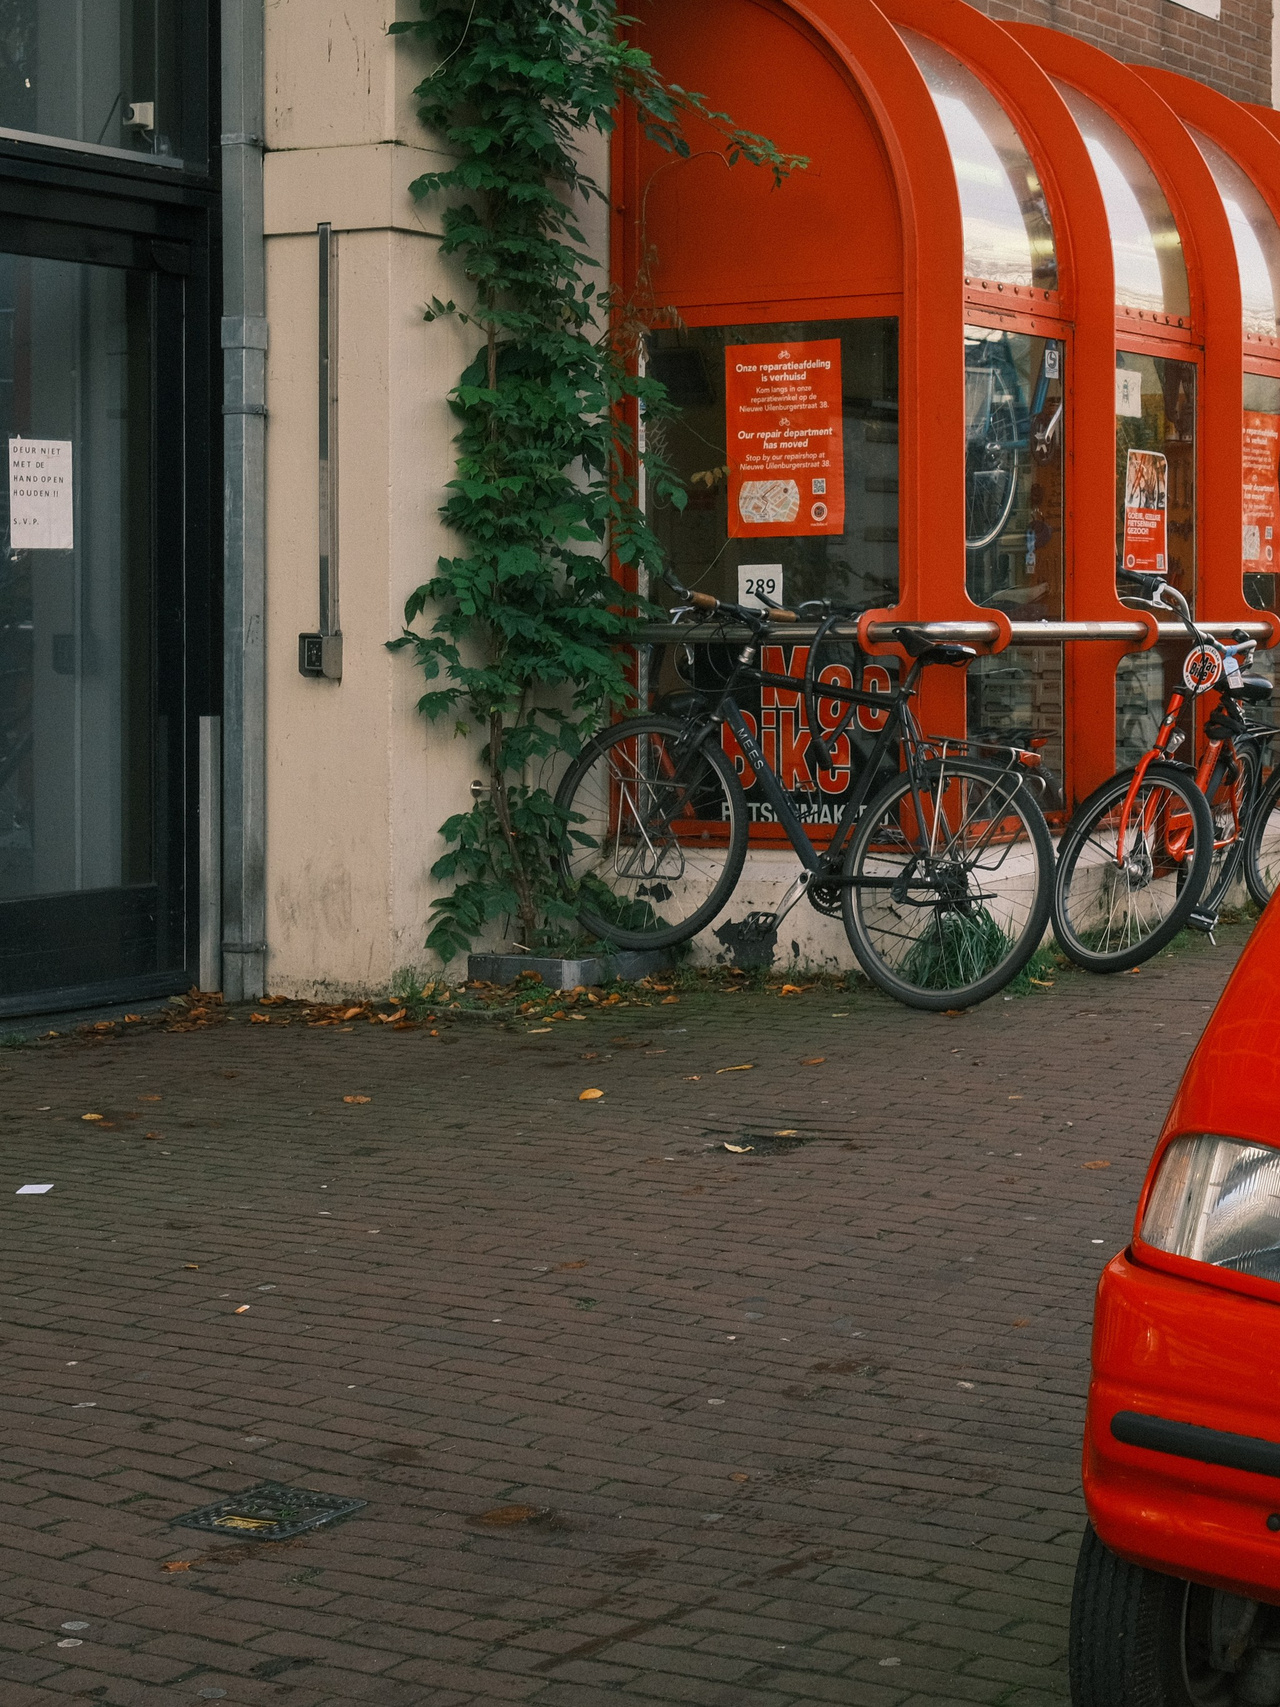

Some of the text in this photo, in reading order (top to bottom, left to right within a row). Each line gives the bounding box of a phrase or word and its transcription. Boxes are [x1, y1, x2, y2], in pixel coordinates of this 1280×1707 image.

[735, 359, 831, 373] Onze reparatieafdeling
[761, 371, 807, 382] is verhuisd
[756, 386, 770, 394] Kom
[771, 385, 788, 394] langs
[790, 385, 796, 393] in
[798, 394, 808, 402] op
[739, 405, 763, 413] Nieuwe
[737, 427, 833, 440] Our repair department
[763, 438, 809, 449] has moved
[12, 446, 61, 455] DEUR NIET
[745, 453, 761, 463] Stop
[762, 453, 770, 462] by
[784, 451, 818, 462] repairshop
[12, 460, 45, 469] MET DE
[740, 463, 764, 471] Nieuwe
[13, 474, 64, 484] HAND OPEN
[13, 489, 50, 497] HOUDEN
[745, 579, 776, 595] 289
[761, 645, 891, 733] Mac
[721, 709, 851, 795] Bike
[736, 727, 765, 771] MEES
